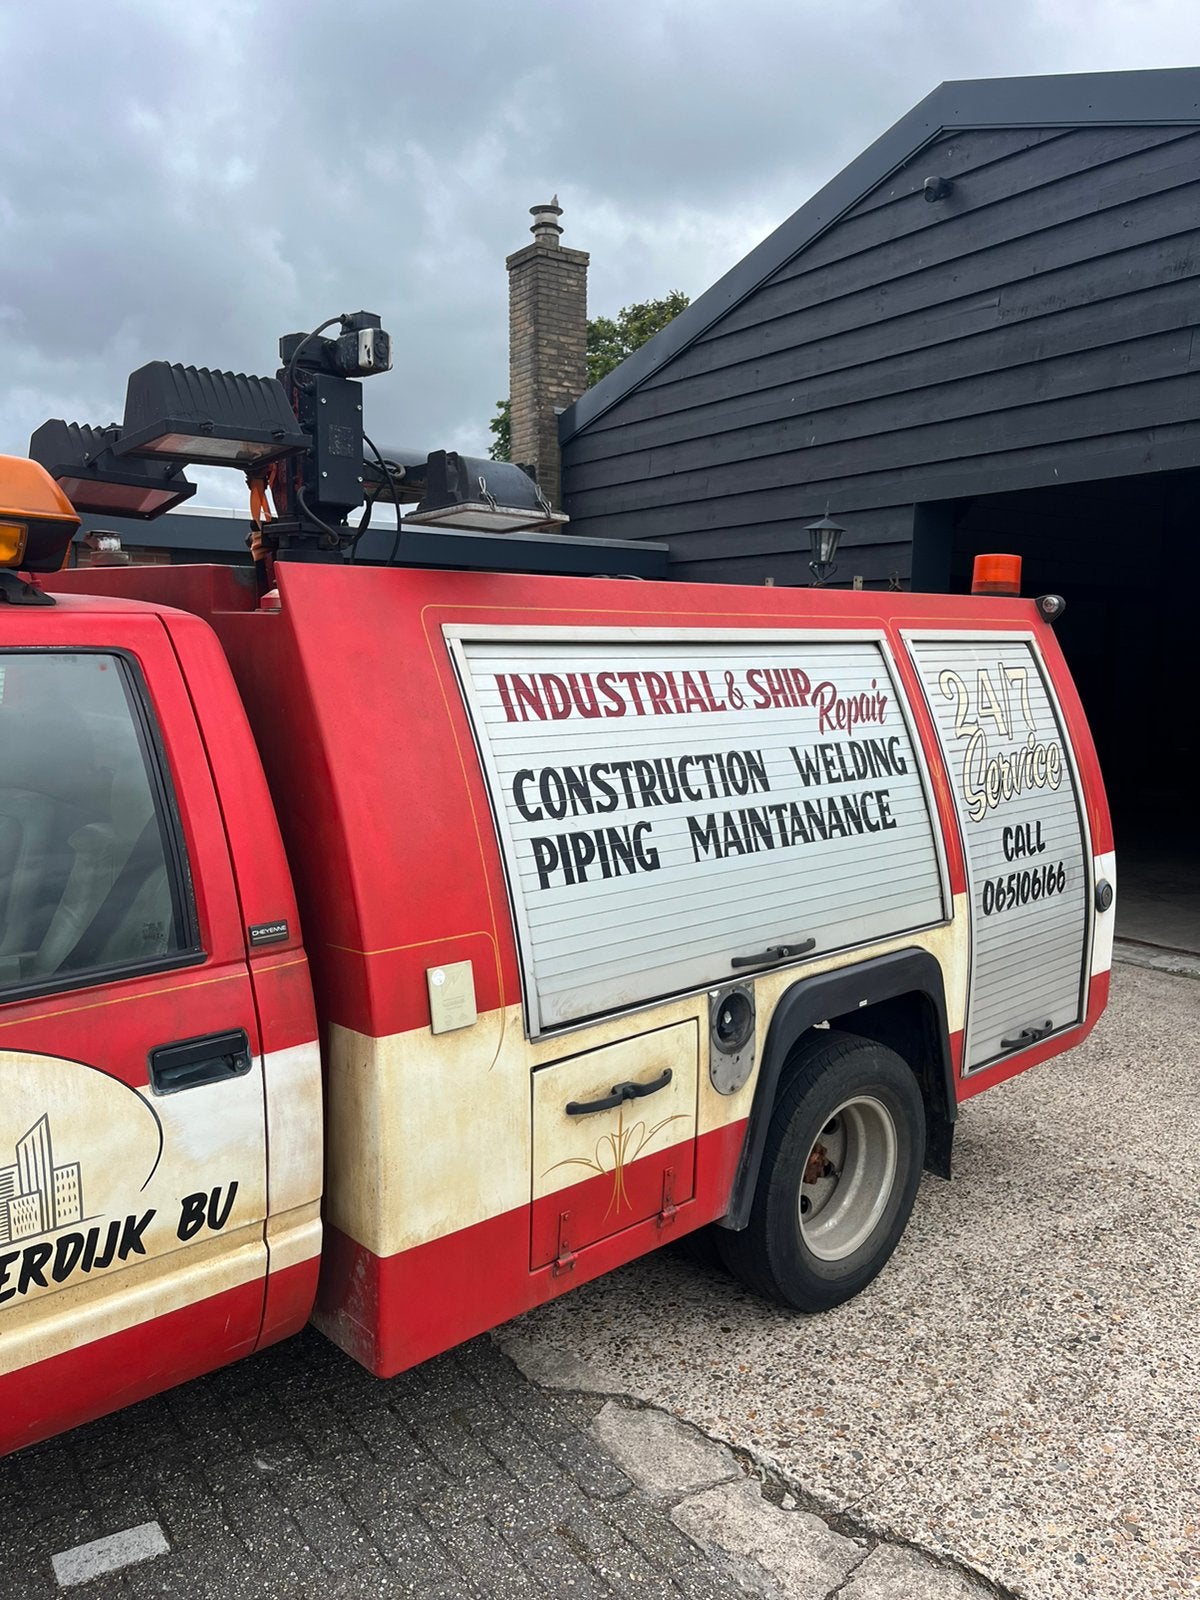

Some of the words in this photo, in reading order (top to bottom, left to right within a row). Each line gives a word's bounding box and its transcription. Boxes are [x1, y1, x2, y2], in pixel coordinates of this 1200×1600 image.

[493, 670, 725, 723] INDUSTRIAL
[723, 669, 750, 711] &
[745, 668, 812, 709] SHIP
[811, 678, 888, 736] Repair
[938, 662, 1037, 740] 24/7
[512, 749, 771, 822] CONSTRUCTION
[789, 736, 908, 787] WELDING
[963, 727, 1062, 822] Service
[530, 820, 661, 890] PIPING
[687, 789, 897, 863] MAINTANANCE
[1002, 820, 1046, 862] CALL
[983, 861, 1066, 915] 065106166
[251, 925, 287, 937] CHEYENNE
